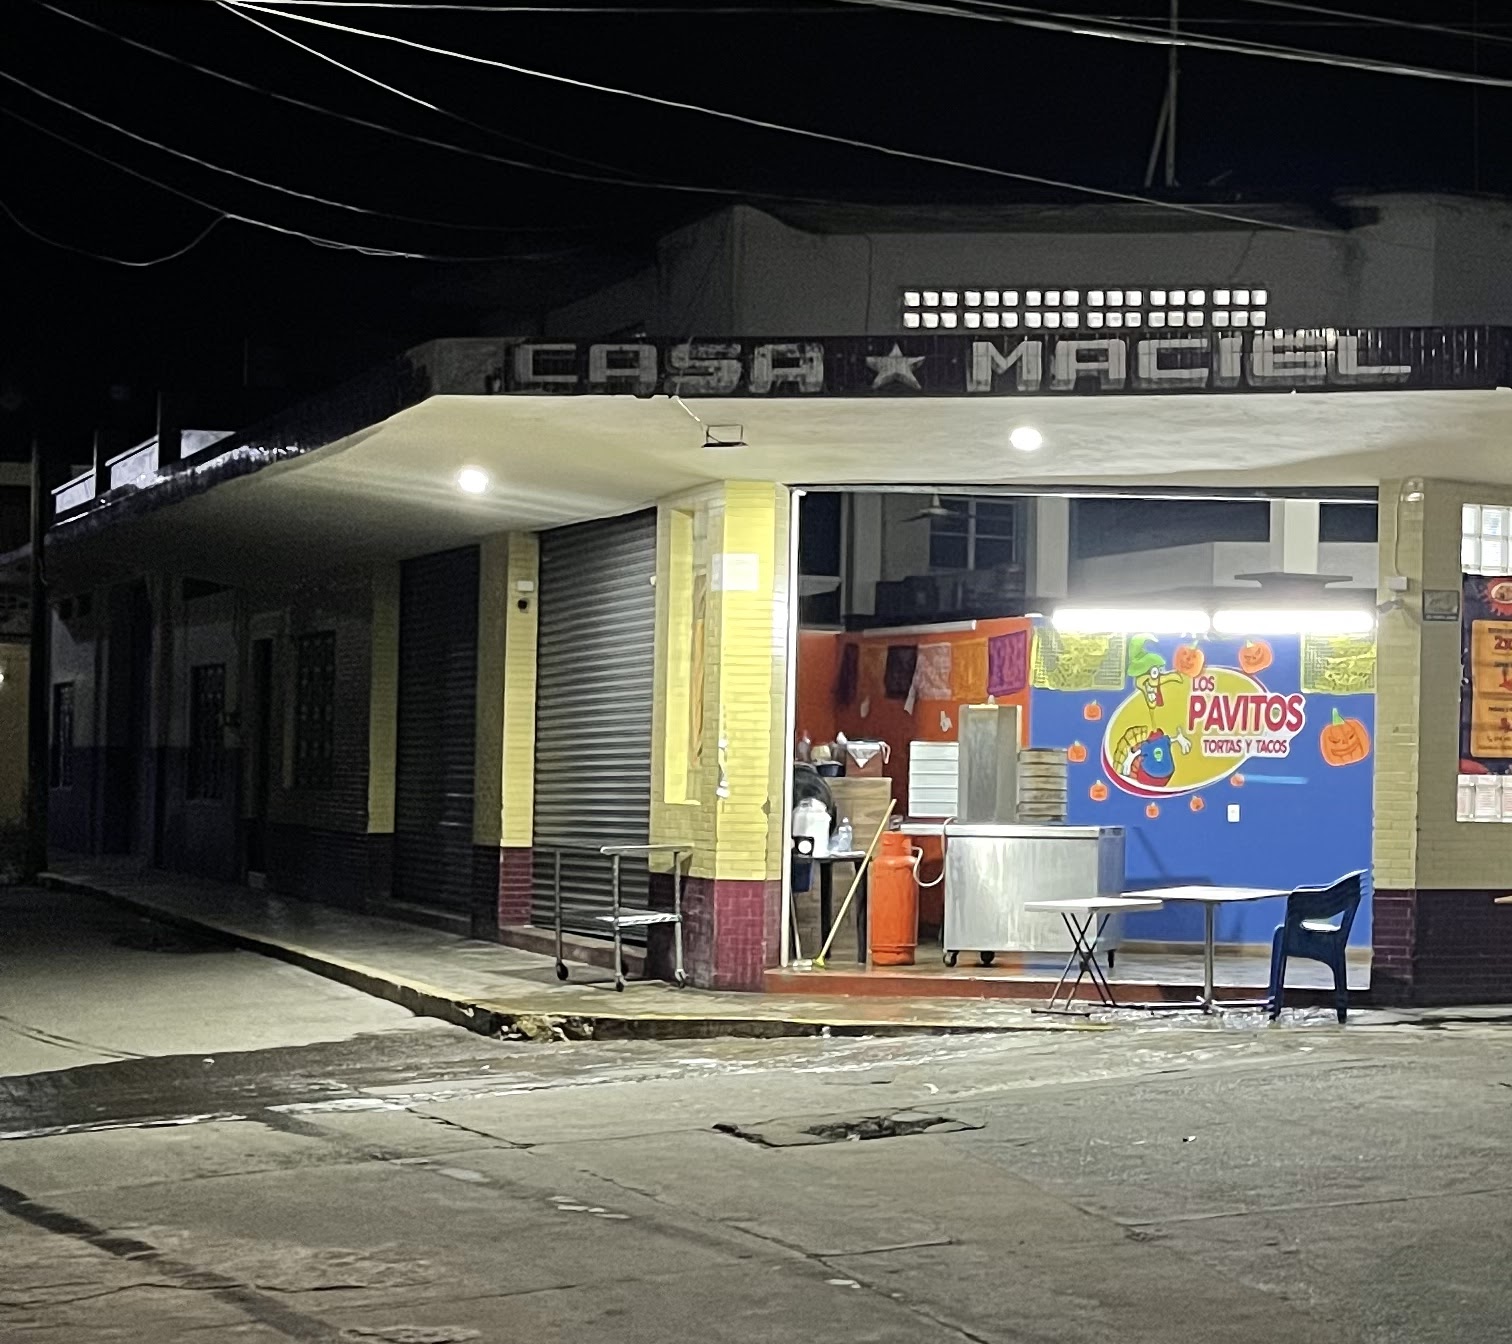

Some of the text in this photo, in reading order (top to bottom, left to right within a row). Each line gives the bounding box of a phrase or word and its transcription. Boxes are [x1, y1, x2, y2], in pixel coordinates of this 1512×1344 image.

[513, 334, 1412, 394] CASA MACIEL
[1192, 675, 1215, 692] LOS
[1188, 694, 1303, 732] PAVITOS
[1203, 739, 1288, 754] TORTAS Y TACOS
